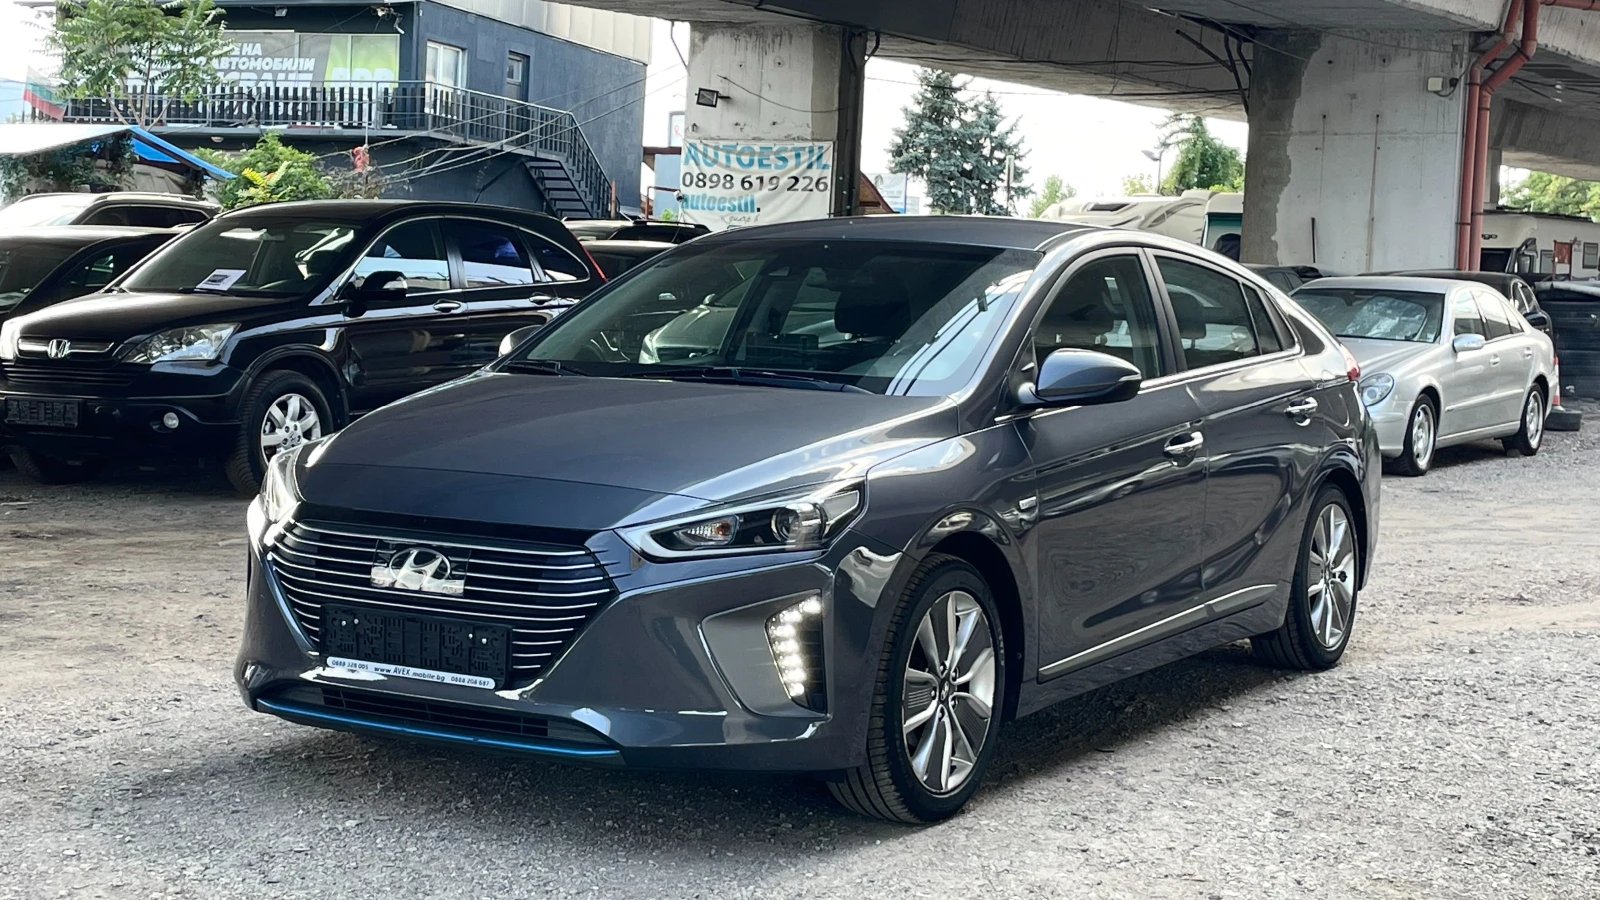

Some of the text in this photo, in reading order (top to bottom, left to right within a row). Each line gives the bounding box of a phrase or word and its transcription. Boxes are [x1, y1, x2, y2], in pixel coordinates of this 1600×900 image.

[683, 142, 831, 171] AUTOESTIL
[682, 171, 829, 193] 0898 619 226
